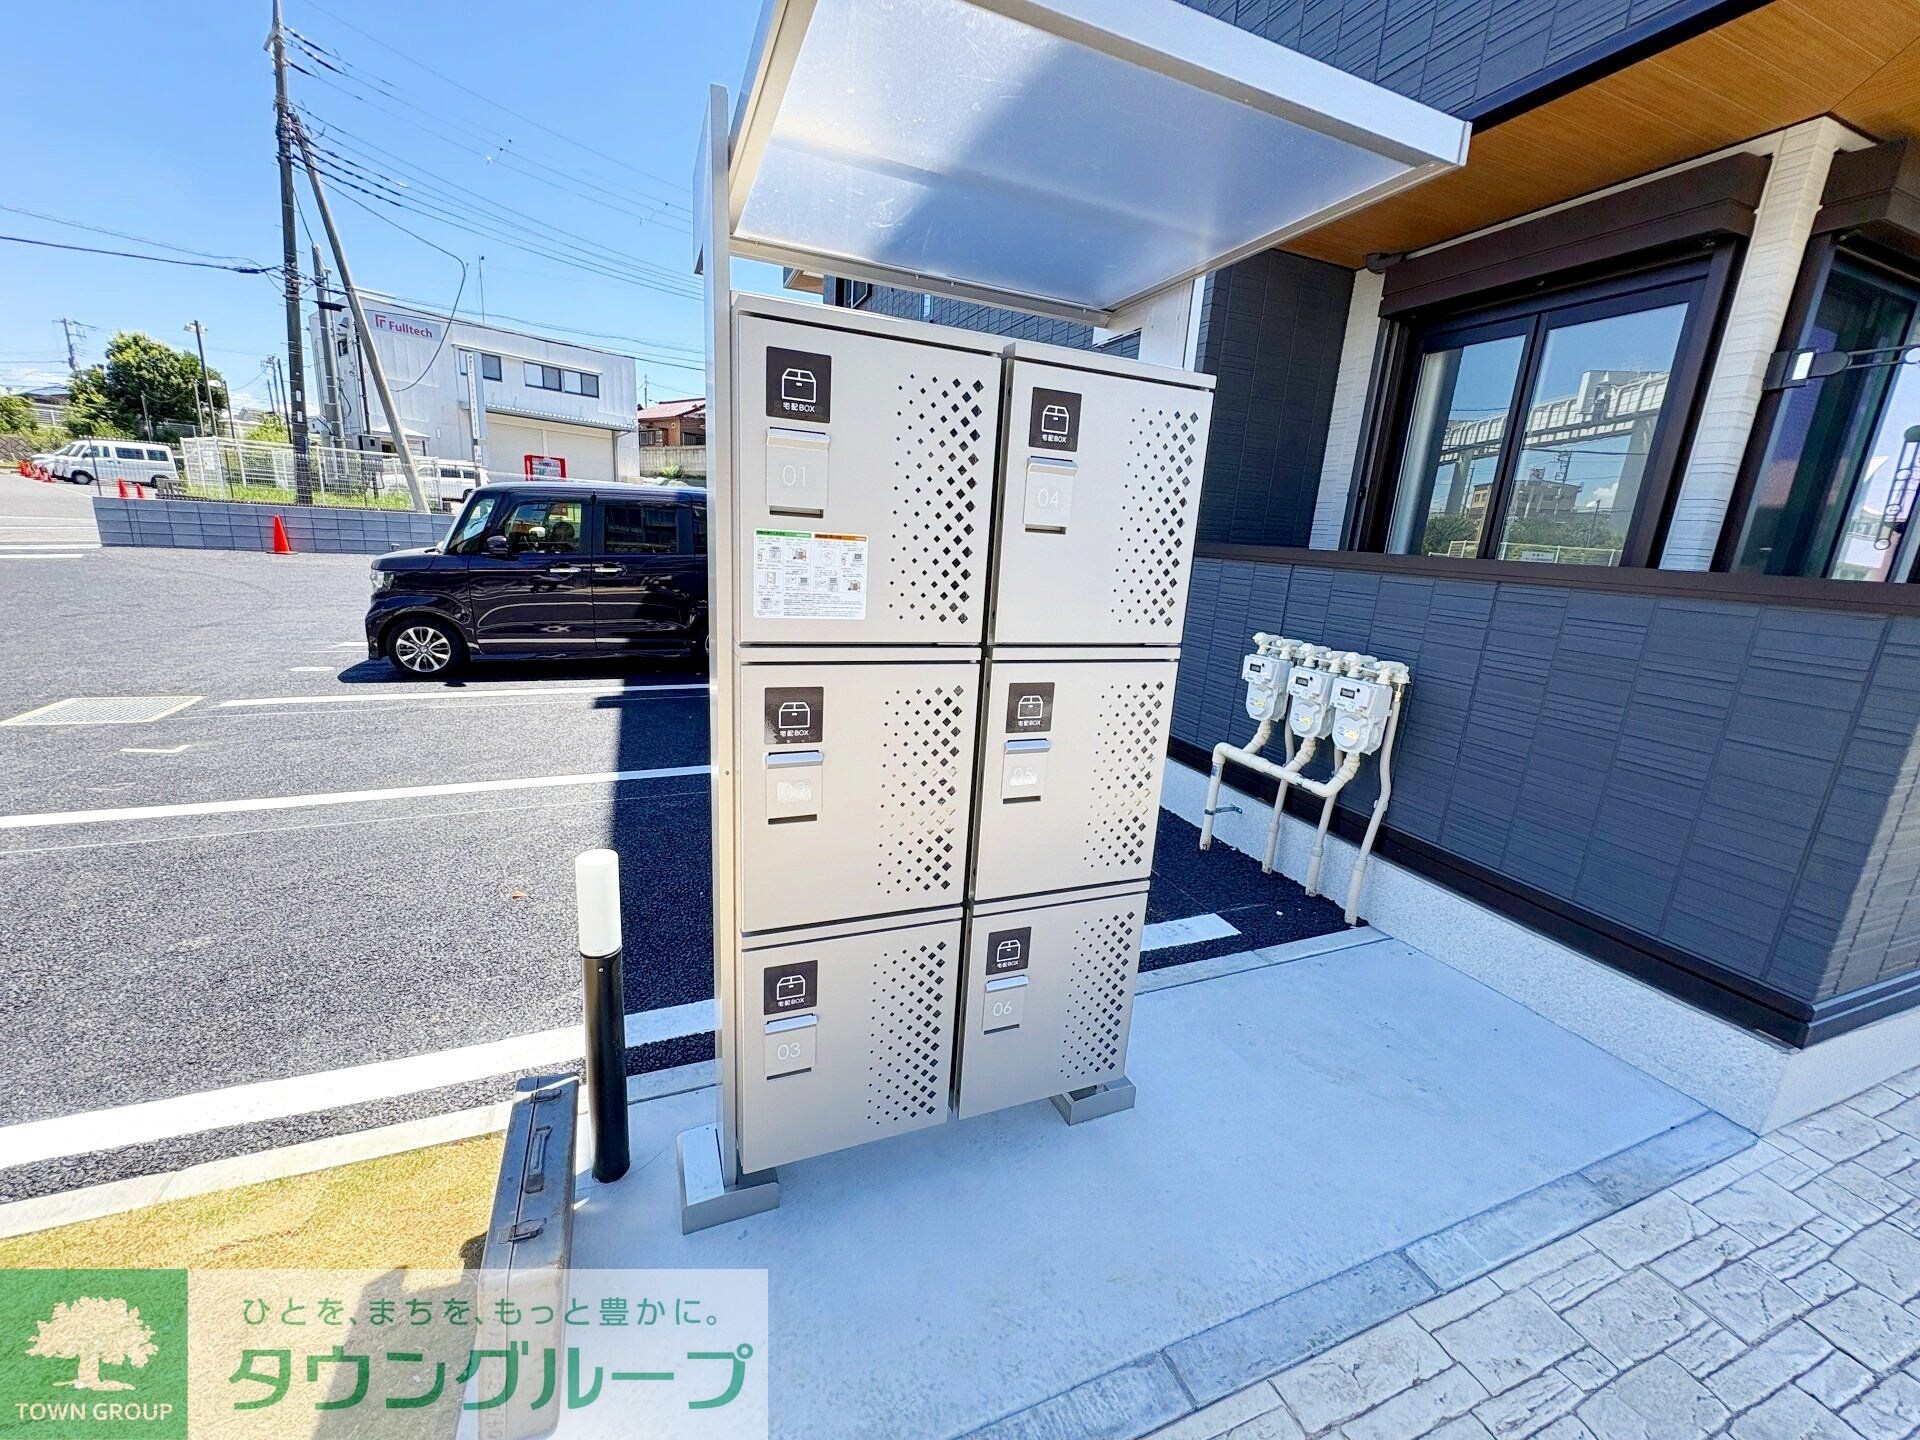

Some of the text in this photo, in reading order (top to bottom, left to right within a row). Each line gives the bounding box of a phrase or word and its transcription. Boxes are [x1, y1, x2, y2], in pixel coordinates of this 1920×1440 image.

[388, 320, 433, 338] Fulltech
[782, 401, 816, 413] 宅配BOX
[1041, 433, 1067, 443] 宅配BOX
[782, 464, 807, 488] 01
[1037, 487, 1061, 508] 04
[779, 728, 810, 738] 宅配BOX
[777, 997, 805, 1007] 宅配BOX
[993, 1000, 1013, 1017] 06
[777, 1042, 801, 1060] 03
